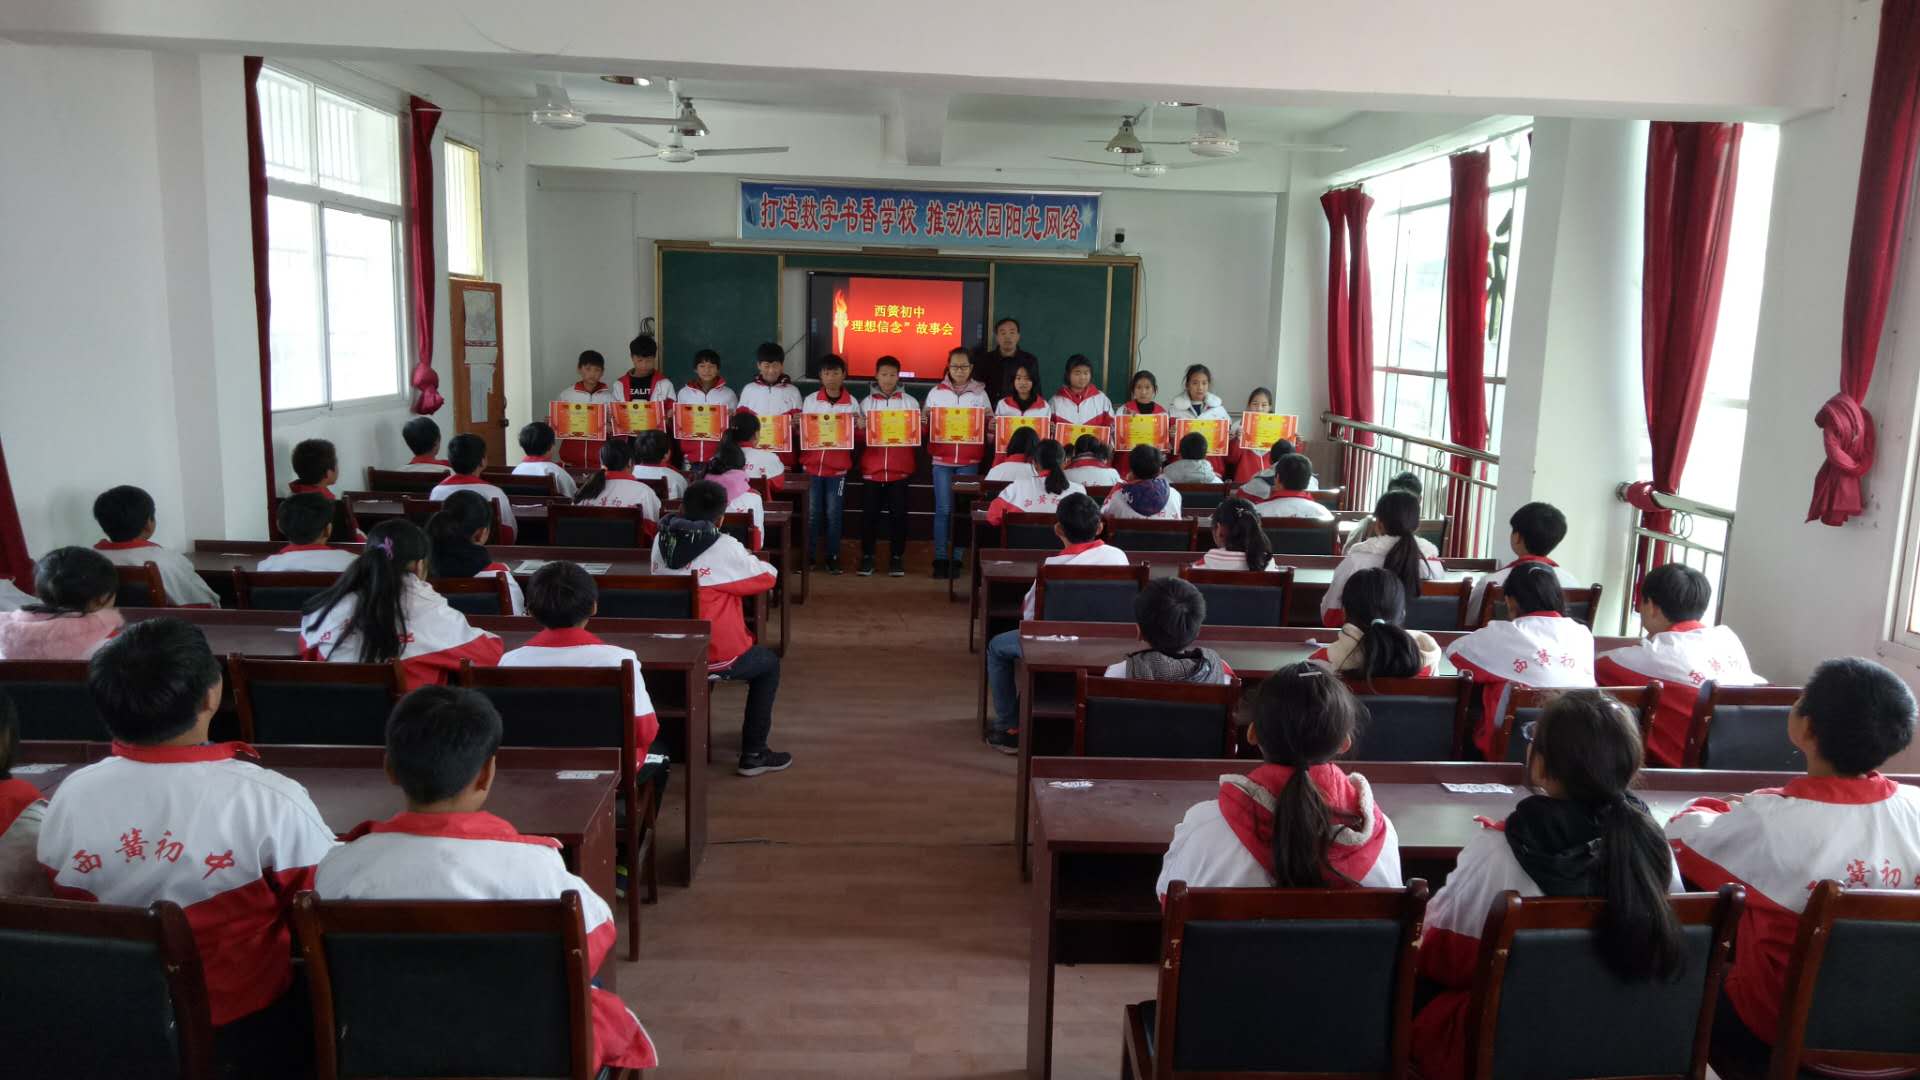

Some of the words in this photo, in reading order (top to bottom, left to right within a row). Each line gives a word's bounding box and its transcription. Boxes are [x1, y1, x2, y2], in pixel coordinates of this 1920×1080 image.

[759, 193, 917, 235] 打造数字书香学校
[926, 200, 1082, 241] 推动校园阳光网络
[874, 304, 925, 319] 西簧初中
[71, 826, 236, 881] 西簧初中
[1806, 858, 1920, 890] 簧初
